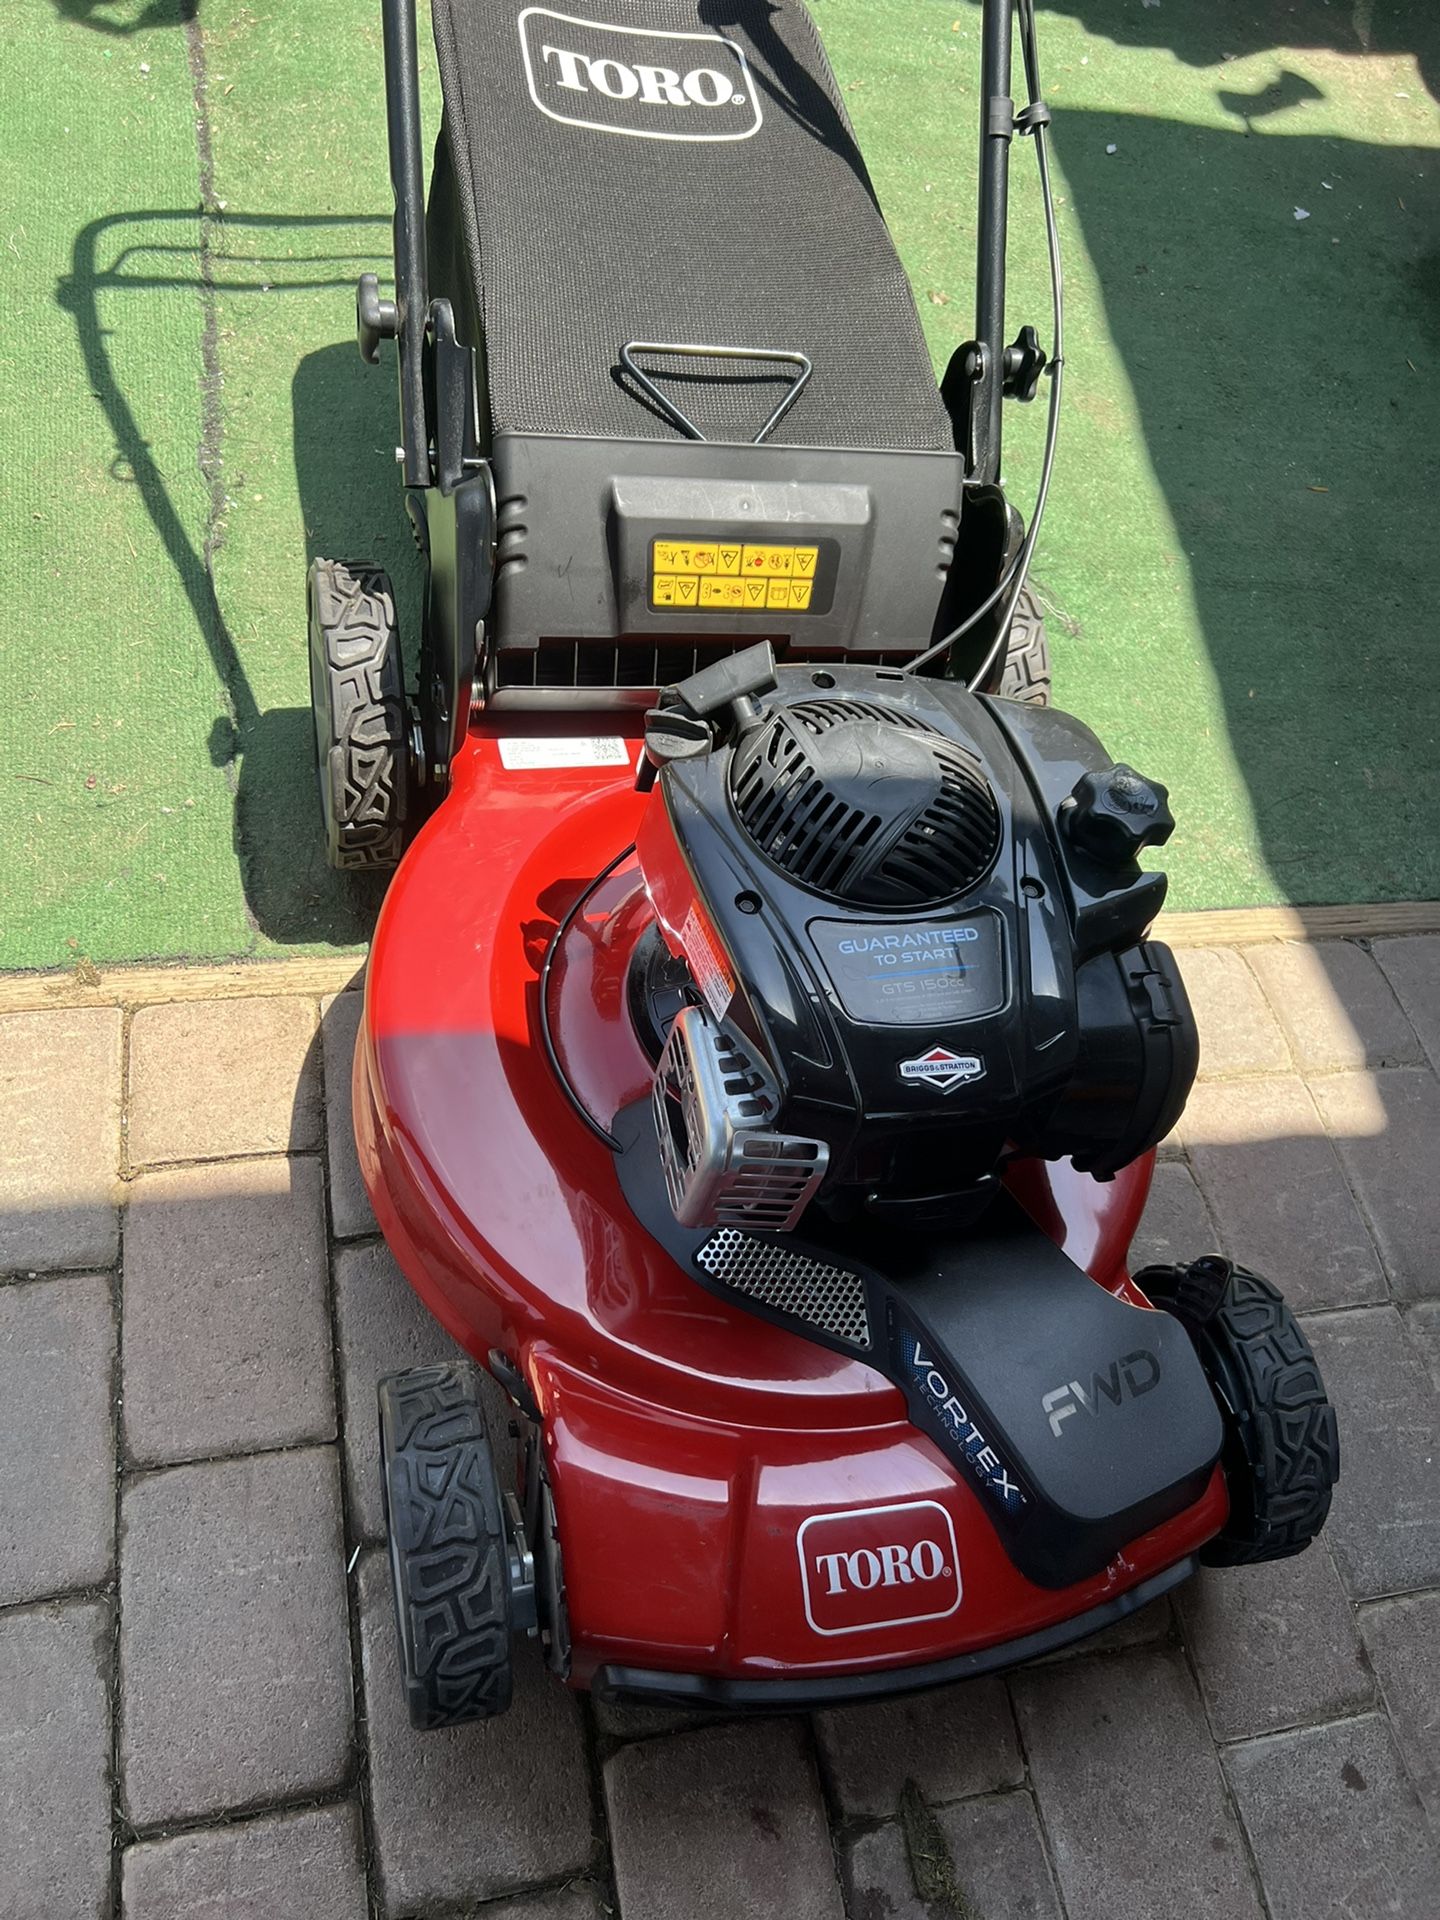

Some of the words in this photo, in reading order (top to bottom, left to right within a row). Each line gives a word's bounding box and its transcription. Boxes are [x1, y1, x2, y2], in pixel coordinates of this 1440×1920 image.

[542, 44, 733, 106] TORO
[838, 927, 979, 954] GUARANTEED
[873, 953, 897, 966] TO
[901, 947, 955, 963] START
[881, 981, 916, 995] GTS
[920, 977, 965, 990] 150cc
[912, 1341, 1020, 1499] VORTEX
[1041, 1349, 1161, 1438] FWD
[912, 1374, 995, 1487] TECHNOLOGY
[815, 1539, 944, 1595] TORO
